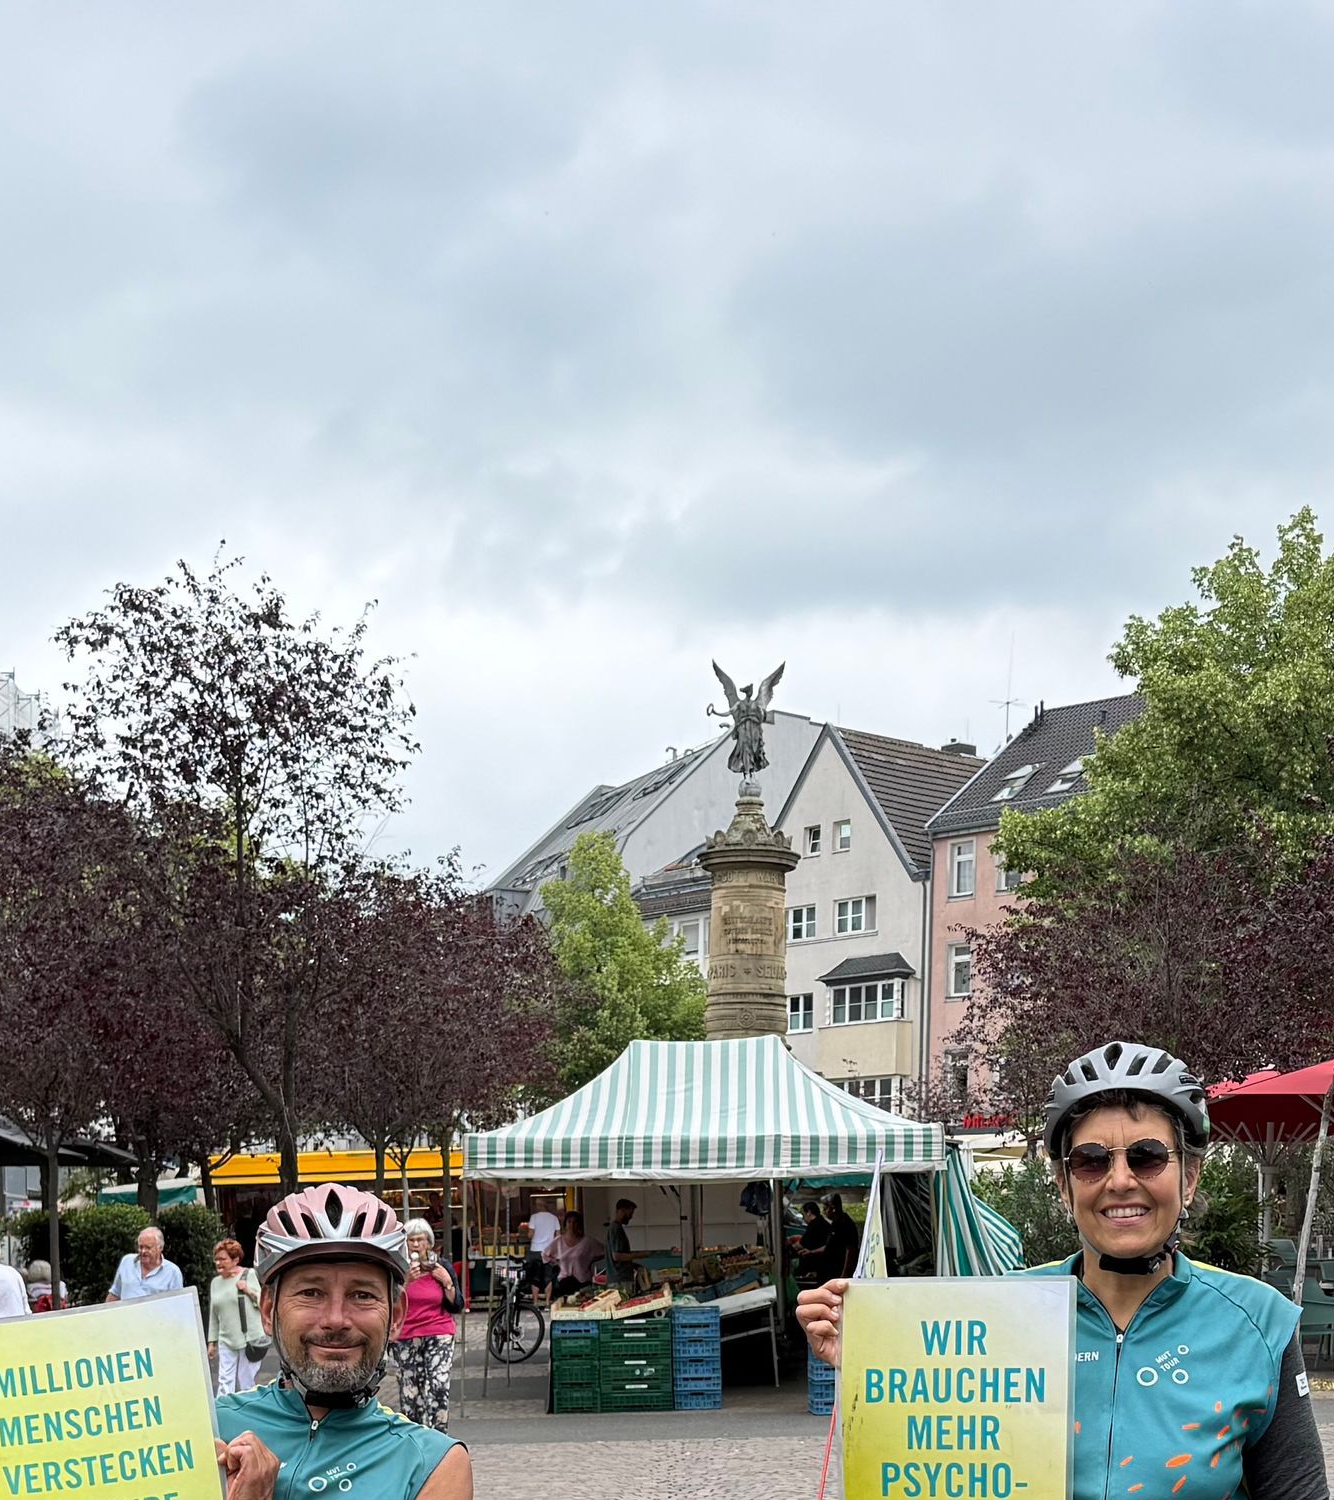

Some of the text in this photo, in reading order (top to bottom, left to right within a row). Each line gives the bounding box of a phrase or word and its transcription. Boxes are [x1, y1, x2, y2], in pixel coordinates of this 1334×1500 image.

[921, 1320, 987, 1356] WIR
[1155, 1350, 1172, 1364] MUT
[1160, 1357, 1180, 1371] TOUR
[865, 1368, 1045, 1403] BRAUCHEN
[907, 1415, 1000, 1450] MEHR
[2, 1439, 194, 1495] VERSTECKEN
[326, 1466, 342, 1476] MUT
[881, 1462, 1028, 1498] PSYCHO-
